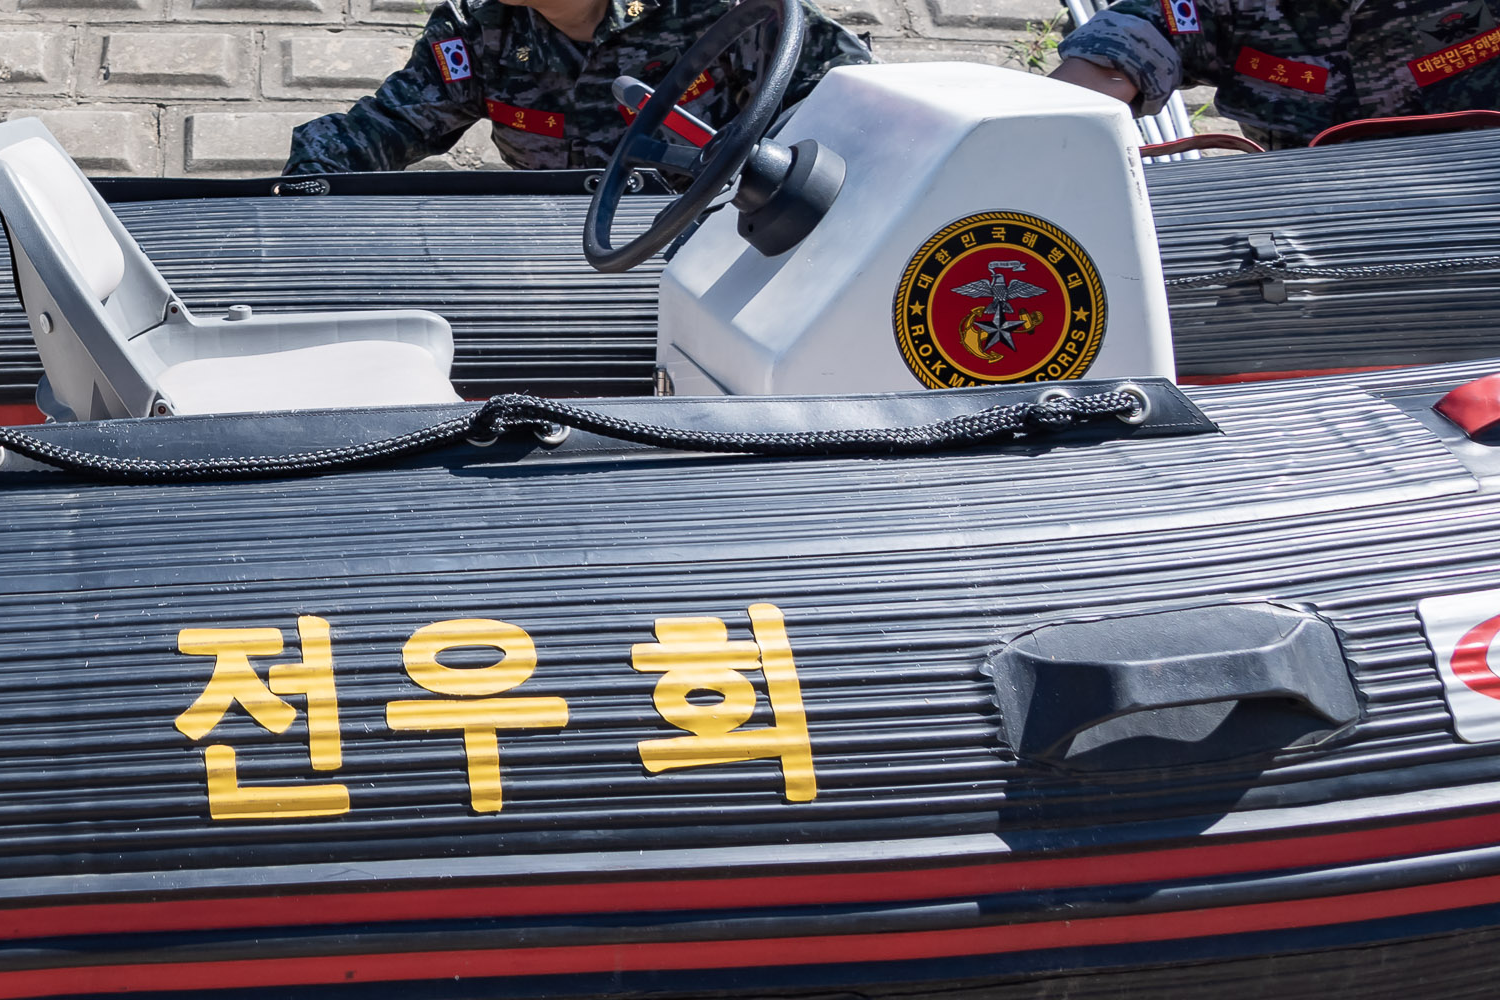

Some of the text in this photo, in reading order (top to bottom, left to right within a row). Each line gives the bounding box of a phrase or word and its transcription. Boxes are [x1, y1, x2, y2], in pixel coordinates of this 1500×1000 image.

[917, 226, 1083, 290] 대한민국해병대
[910, 324, 947, 375] R.O.K
[175, 603, 817, 820] 전우회
